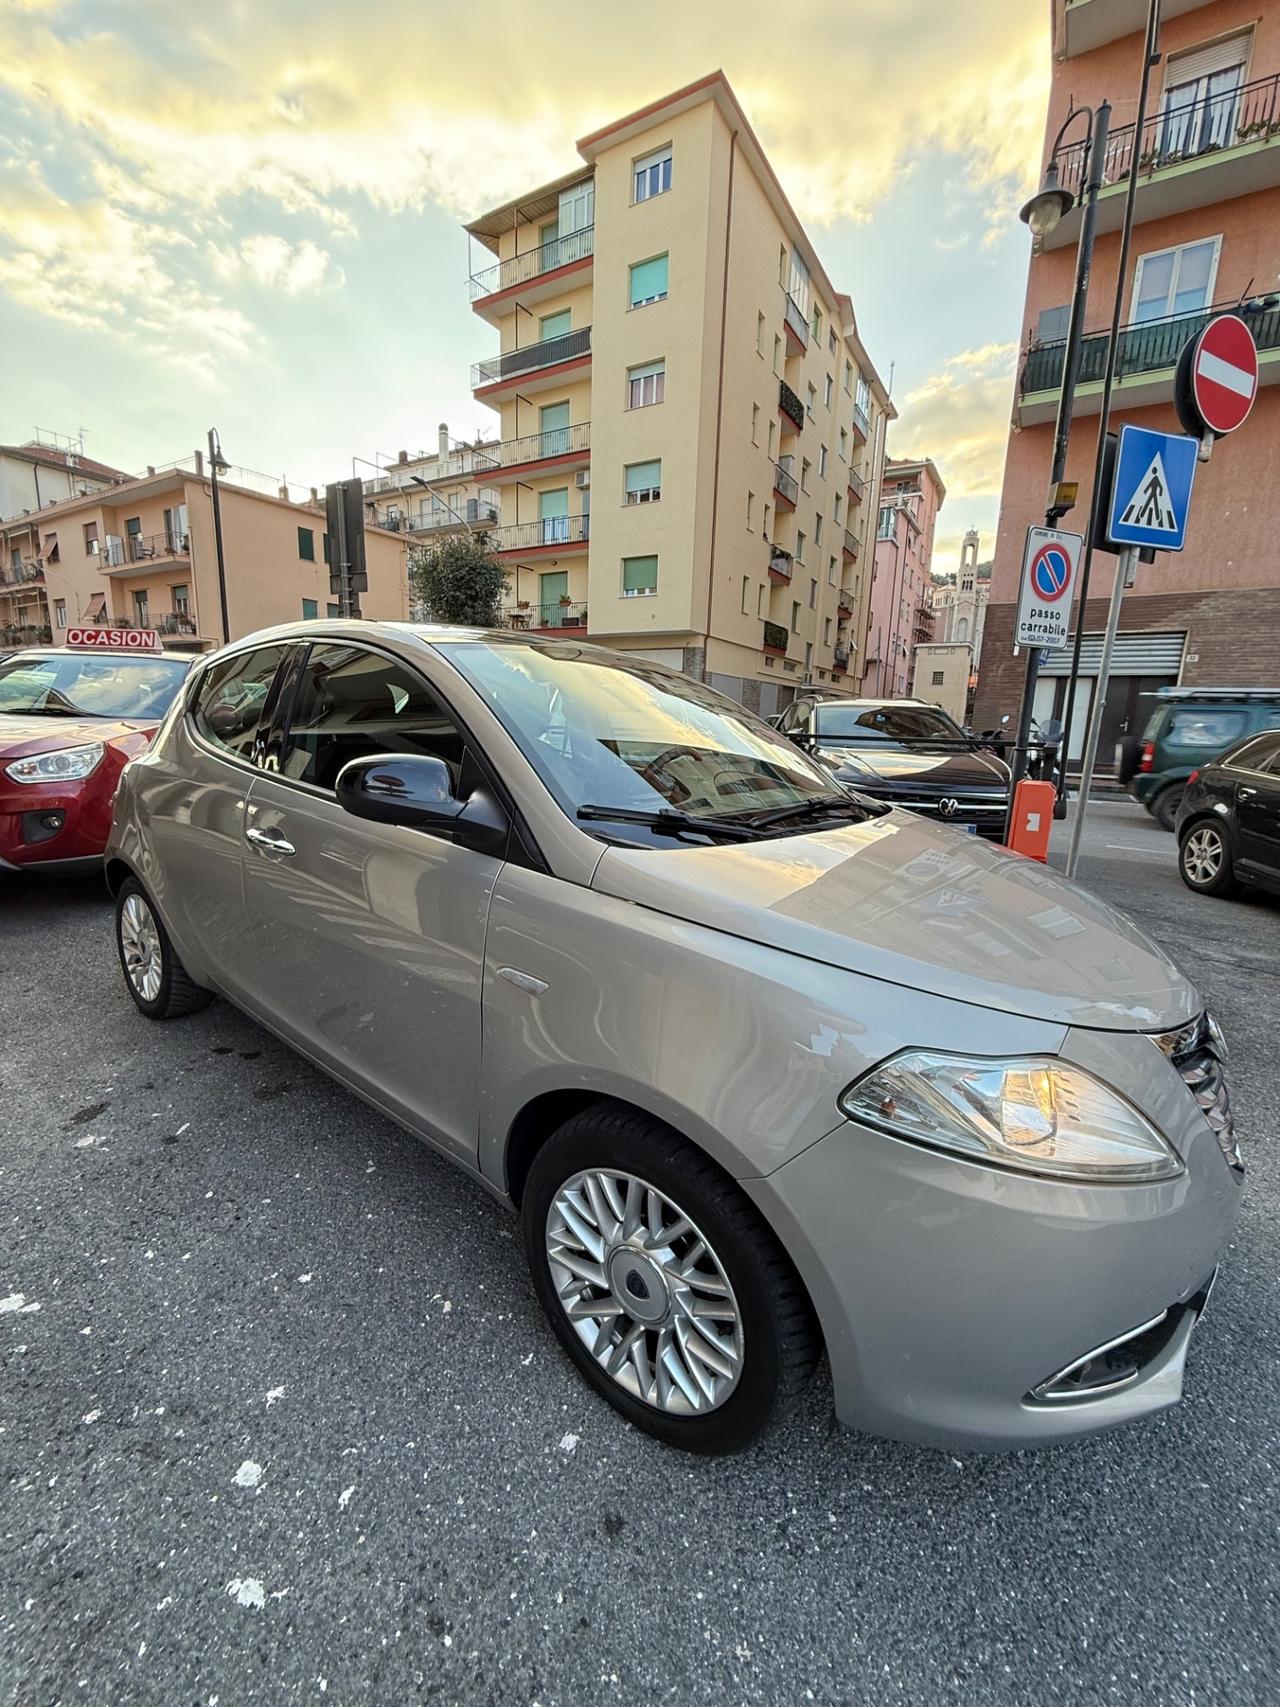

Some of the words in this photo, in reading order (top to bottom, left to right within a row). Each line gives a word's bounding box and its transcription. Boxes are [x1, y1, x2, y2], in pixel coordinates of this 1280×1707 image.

[1030, 608, 1061, 620] passo
[1020, 622, 1066, 636] carrabile
[68, 630, 153, 646] OCASION
